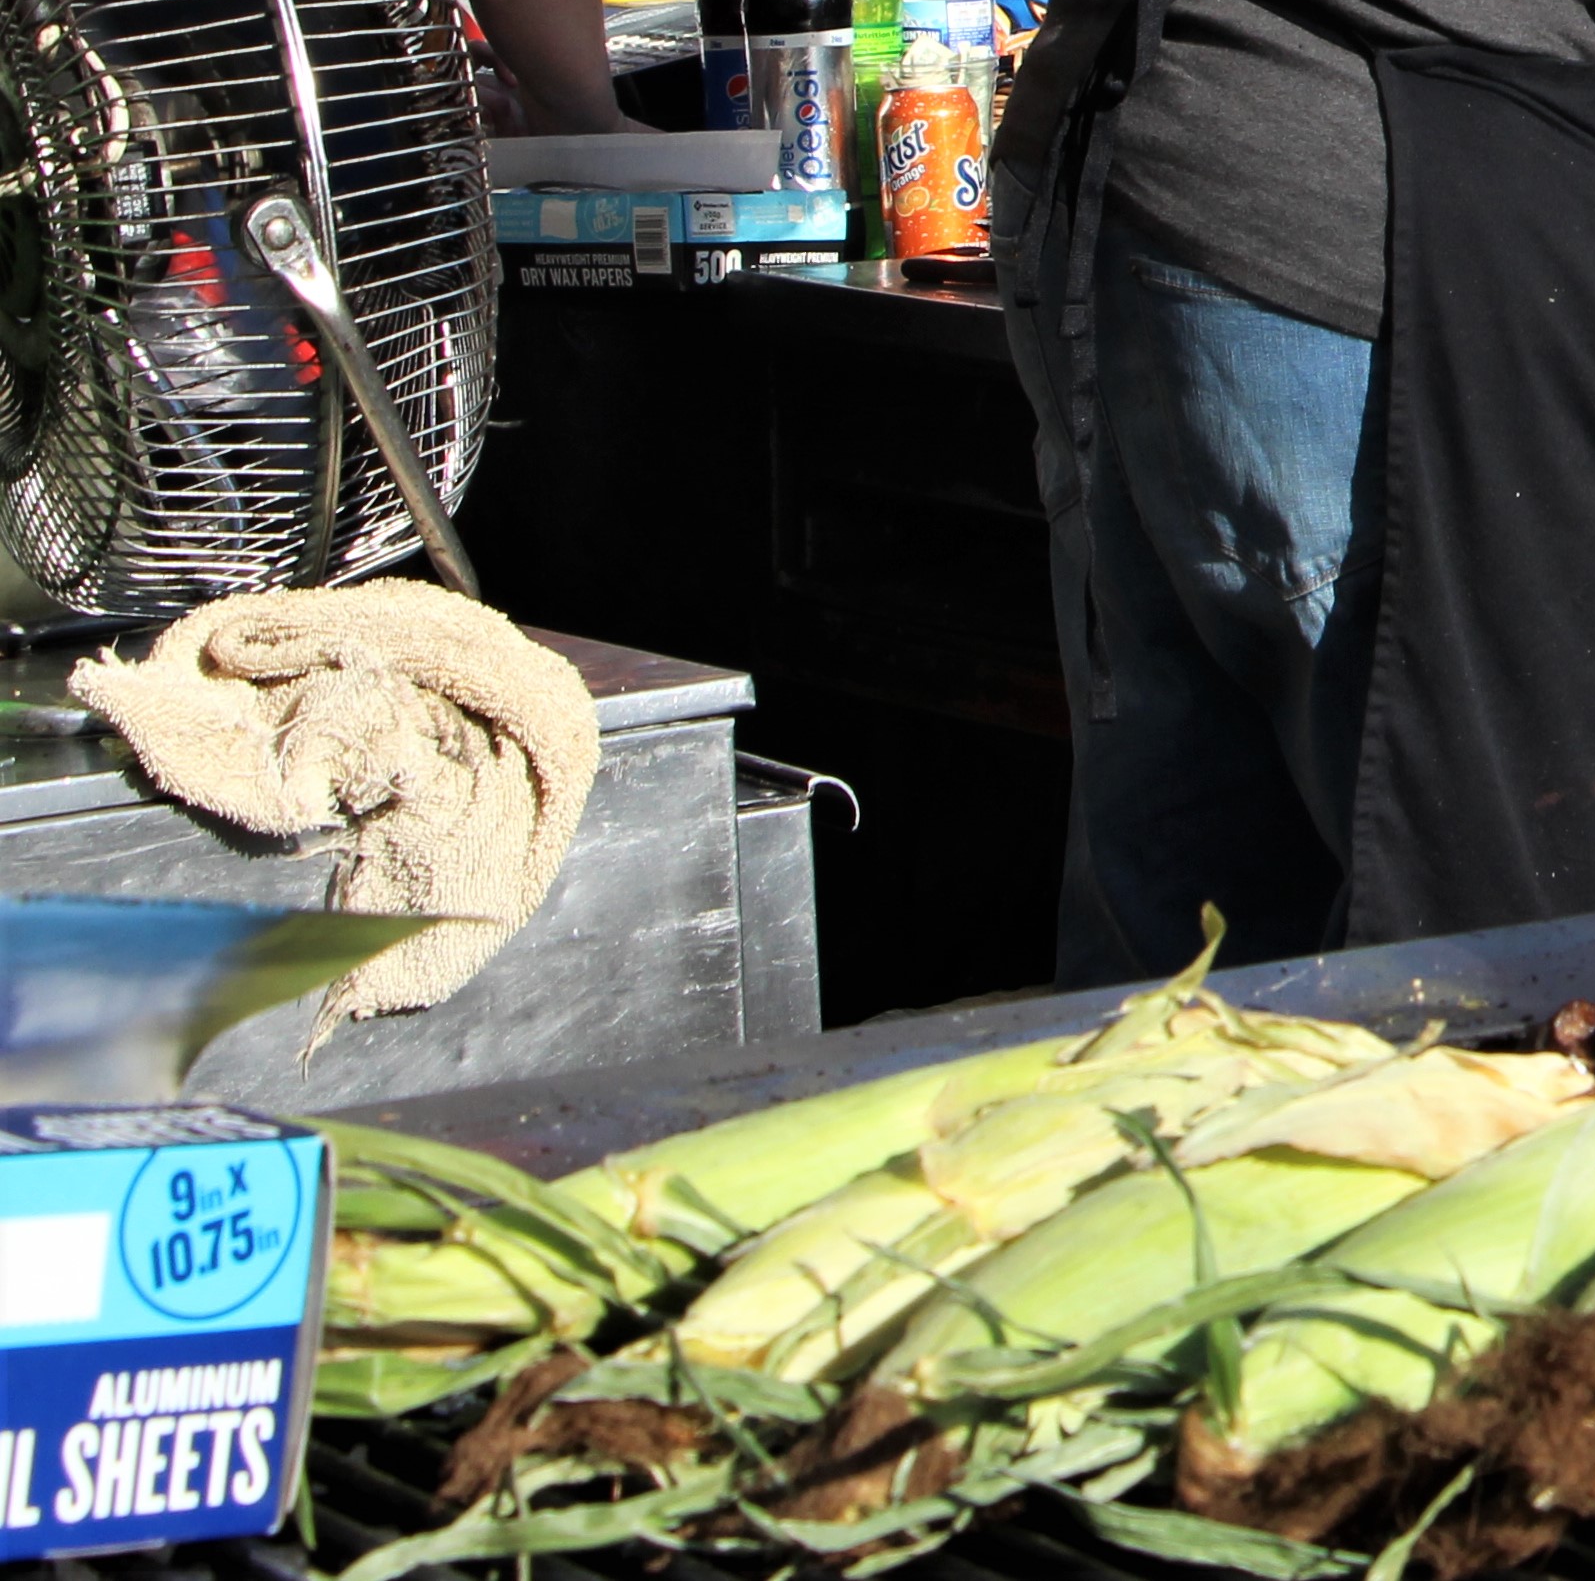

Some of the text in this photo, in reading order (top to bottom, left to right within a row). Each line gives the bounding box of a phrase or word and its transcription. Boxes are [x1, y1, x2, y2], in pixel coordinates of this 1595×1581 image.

[787, 69, 832, 180] pepsi
[780, 142, 794, 180] diet
[880, 119, 929, 184] kist
[891, 163, 926, 192] Orange
[521, 268, 633, 287] DRY WAX PAPERS
[535, 253, 630, 266] HEAVYWEIGHT PREMIUM
[695, 248, 742, 285] 500
[88, 1357, 283, 1420] ALUMINUM
[0, 1406, 277, 1531] IL SHEETS
